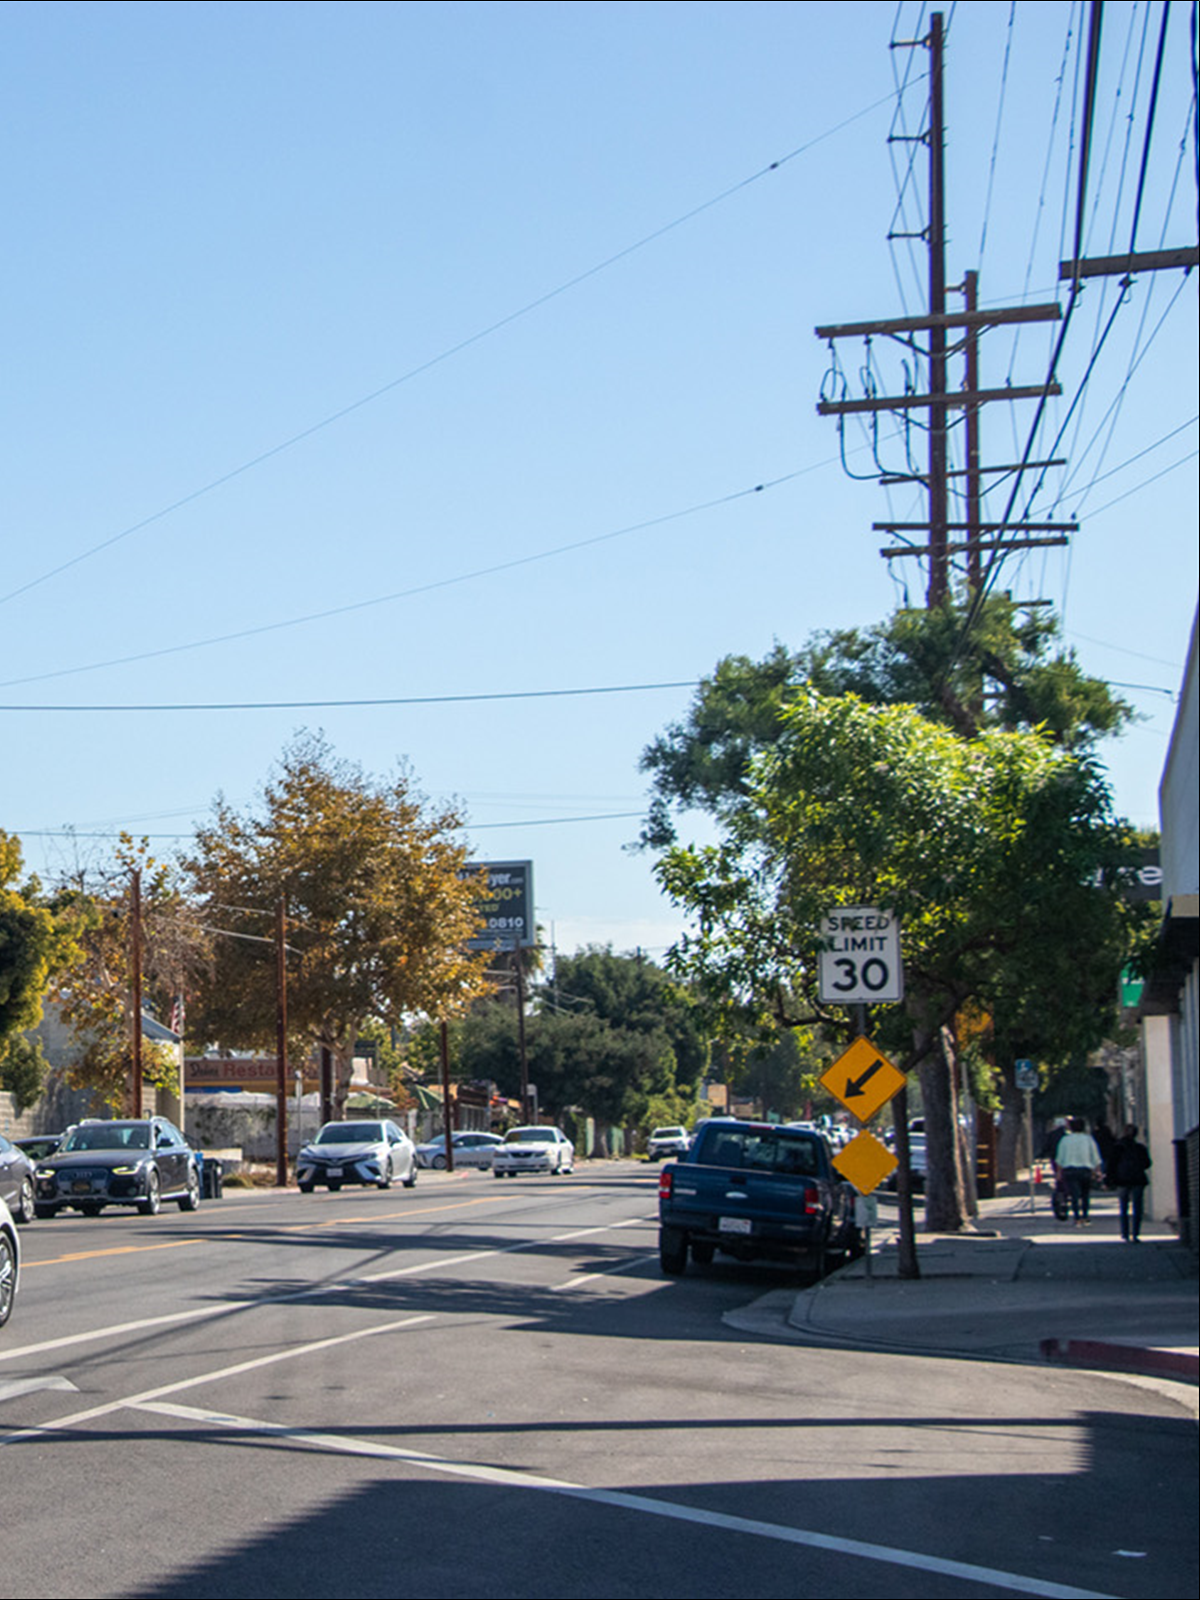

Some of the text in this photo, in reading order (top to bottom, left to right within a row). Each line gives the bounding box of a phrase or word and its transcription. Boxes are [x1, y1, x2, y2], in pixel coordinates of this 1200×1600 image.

[828, 916, 890, 931] SPEED
[829, 937, 888, 953] LIMIT
[831, 958, 889, 992] 30
